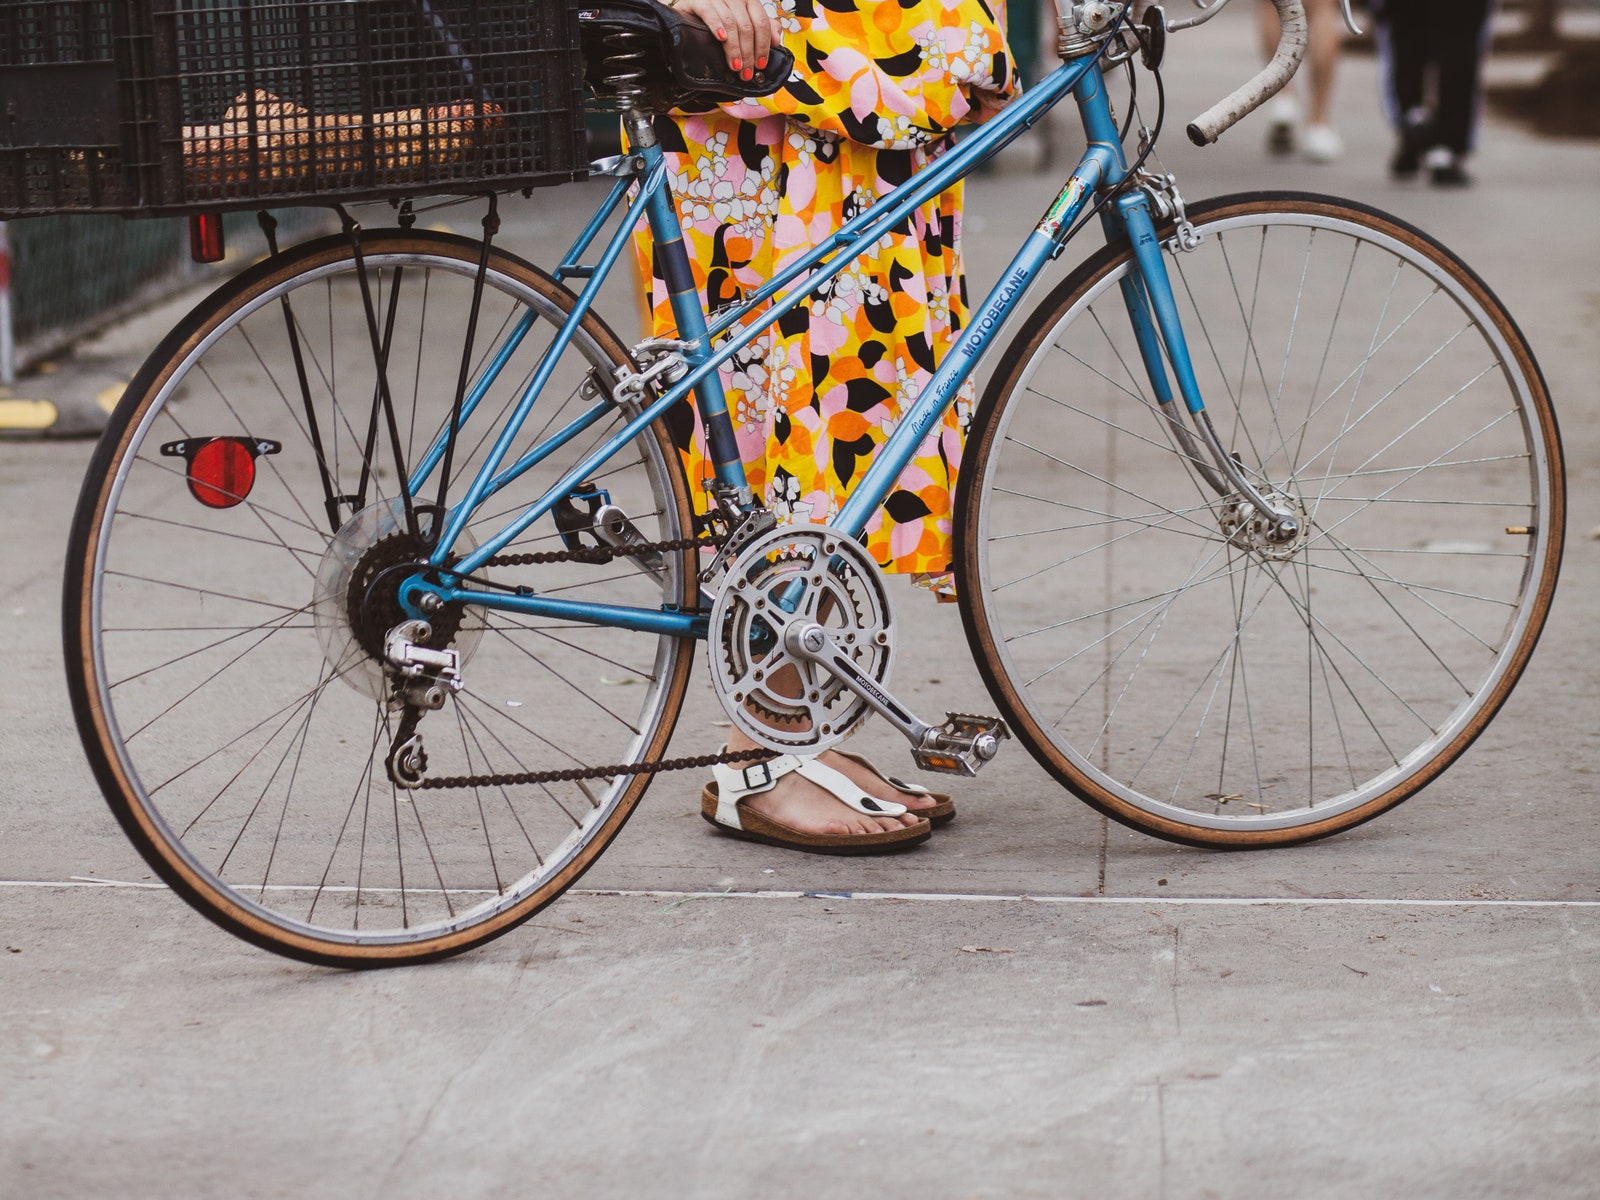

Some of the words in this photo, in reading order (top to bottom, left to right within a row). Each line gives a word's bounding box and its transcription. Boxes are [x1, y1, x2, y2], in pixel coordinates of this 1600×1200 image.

[961, 267, 1028, 357] MOTOBECANE
[911, 409, 931, 435] Made
[931, 398, 940, 411] in
[936, 369, 959, 399] France
[855, 675, 889, 705] MOTOBECANE
